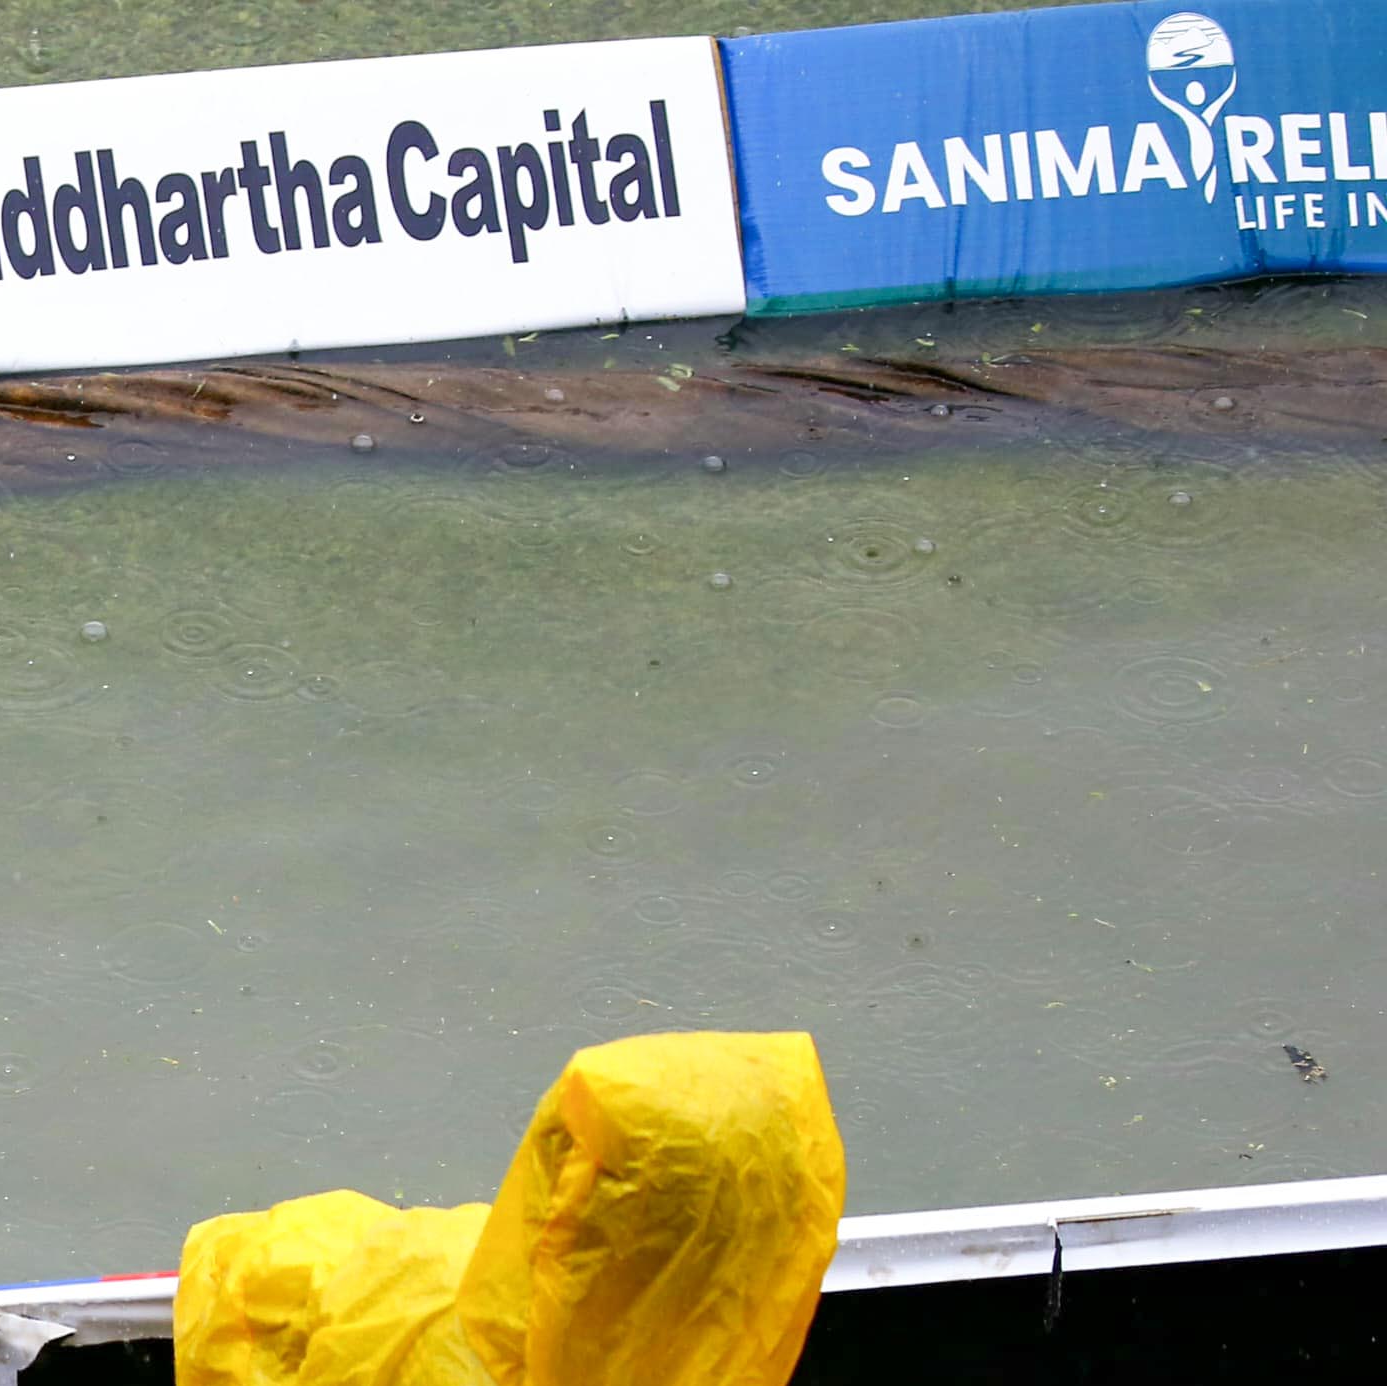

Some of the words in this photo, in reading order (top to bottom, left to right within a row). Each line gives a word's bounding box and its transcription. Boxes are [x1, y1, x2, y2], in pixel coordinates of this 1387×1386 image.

[821, 122, 1187, 217] SANIMA
[1224, 112, 1387, 184] RELI
[1234, 192, 1326, 230] LIFE
